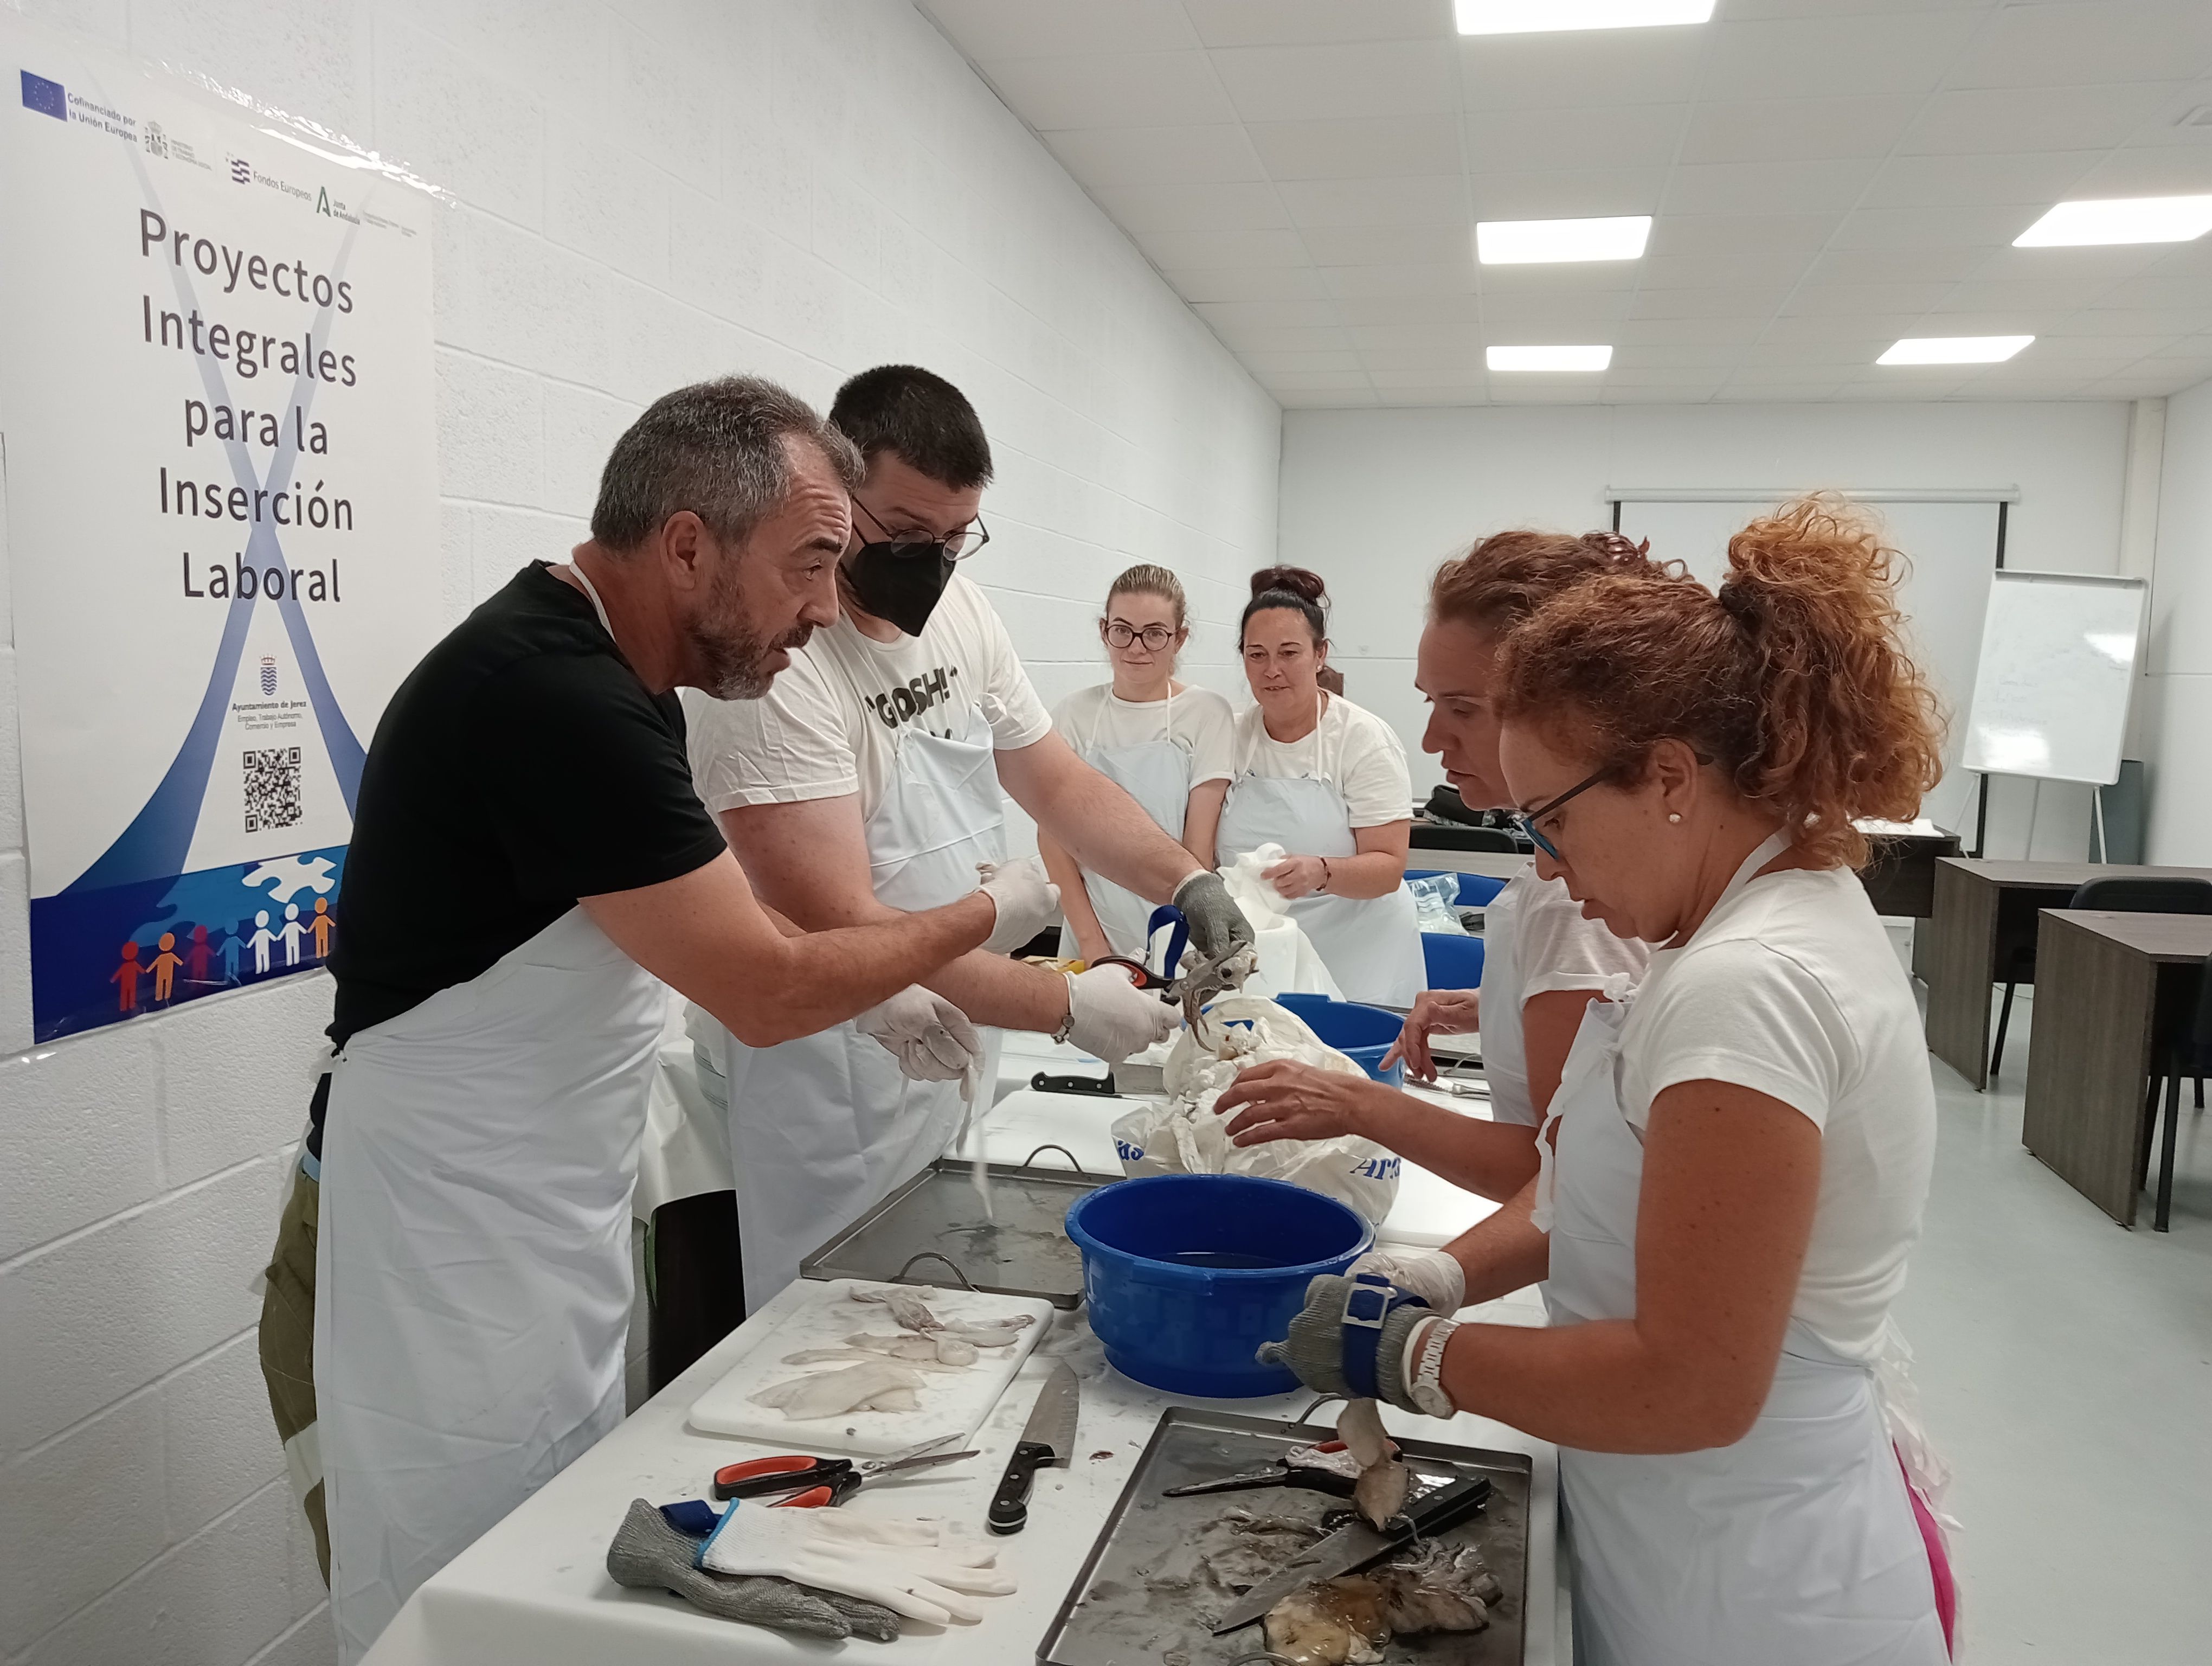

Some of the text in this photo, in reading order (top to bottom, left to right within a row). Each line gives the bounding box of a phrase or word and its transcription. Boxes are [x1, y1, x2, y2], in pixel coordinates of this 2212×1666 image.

[68, 92, 136, 126] Cofinanciado por
[69, 109, 137, 142] la Unión Europea
[253, 170, 312, 201] Fondos Europeos
[140, 208, 353, 314] Proyectos
[143, 294, 357, 387] Integrales
[184, 399, 328, 455] para la
[160, 466, 353, 531] Inserción
[183, 552, 340, 603] Laboral
[232, 702, 279, 713] Ayuntamiento
[290, 700, 307, 709] Jerez
